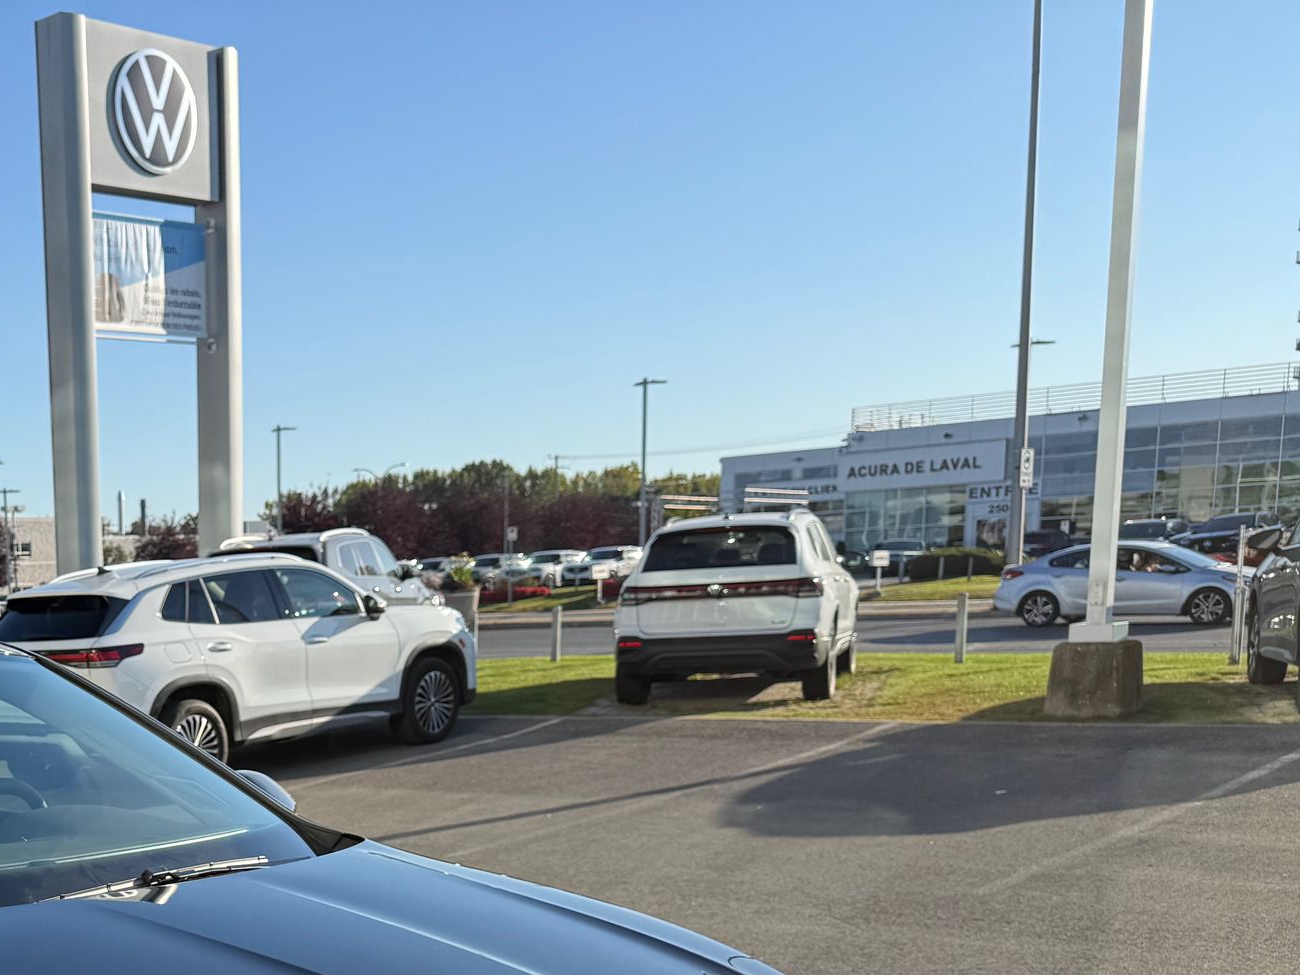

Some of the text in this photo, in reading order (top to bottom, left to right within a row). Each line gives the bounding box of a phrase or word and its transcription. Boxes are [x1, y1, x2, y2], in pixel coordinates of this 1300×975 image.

[118, 53, 193, 166] VW
[847, 456, 981, 479] ACURA DE LAVAL
[969, 482, 1039, 499] ENTRE
